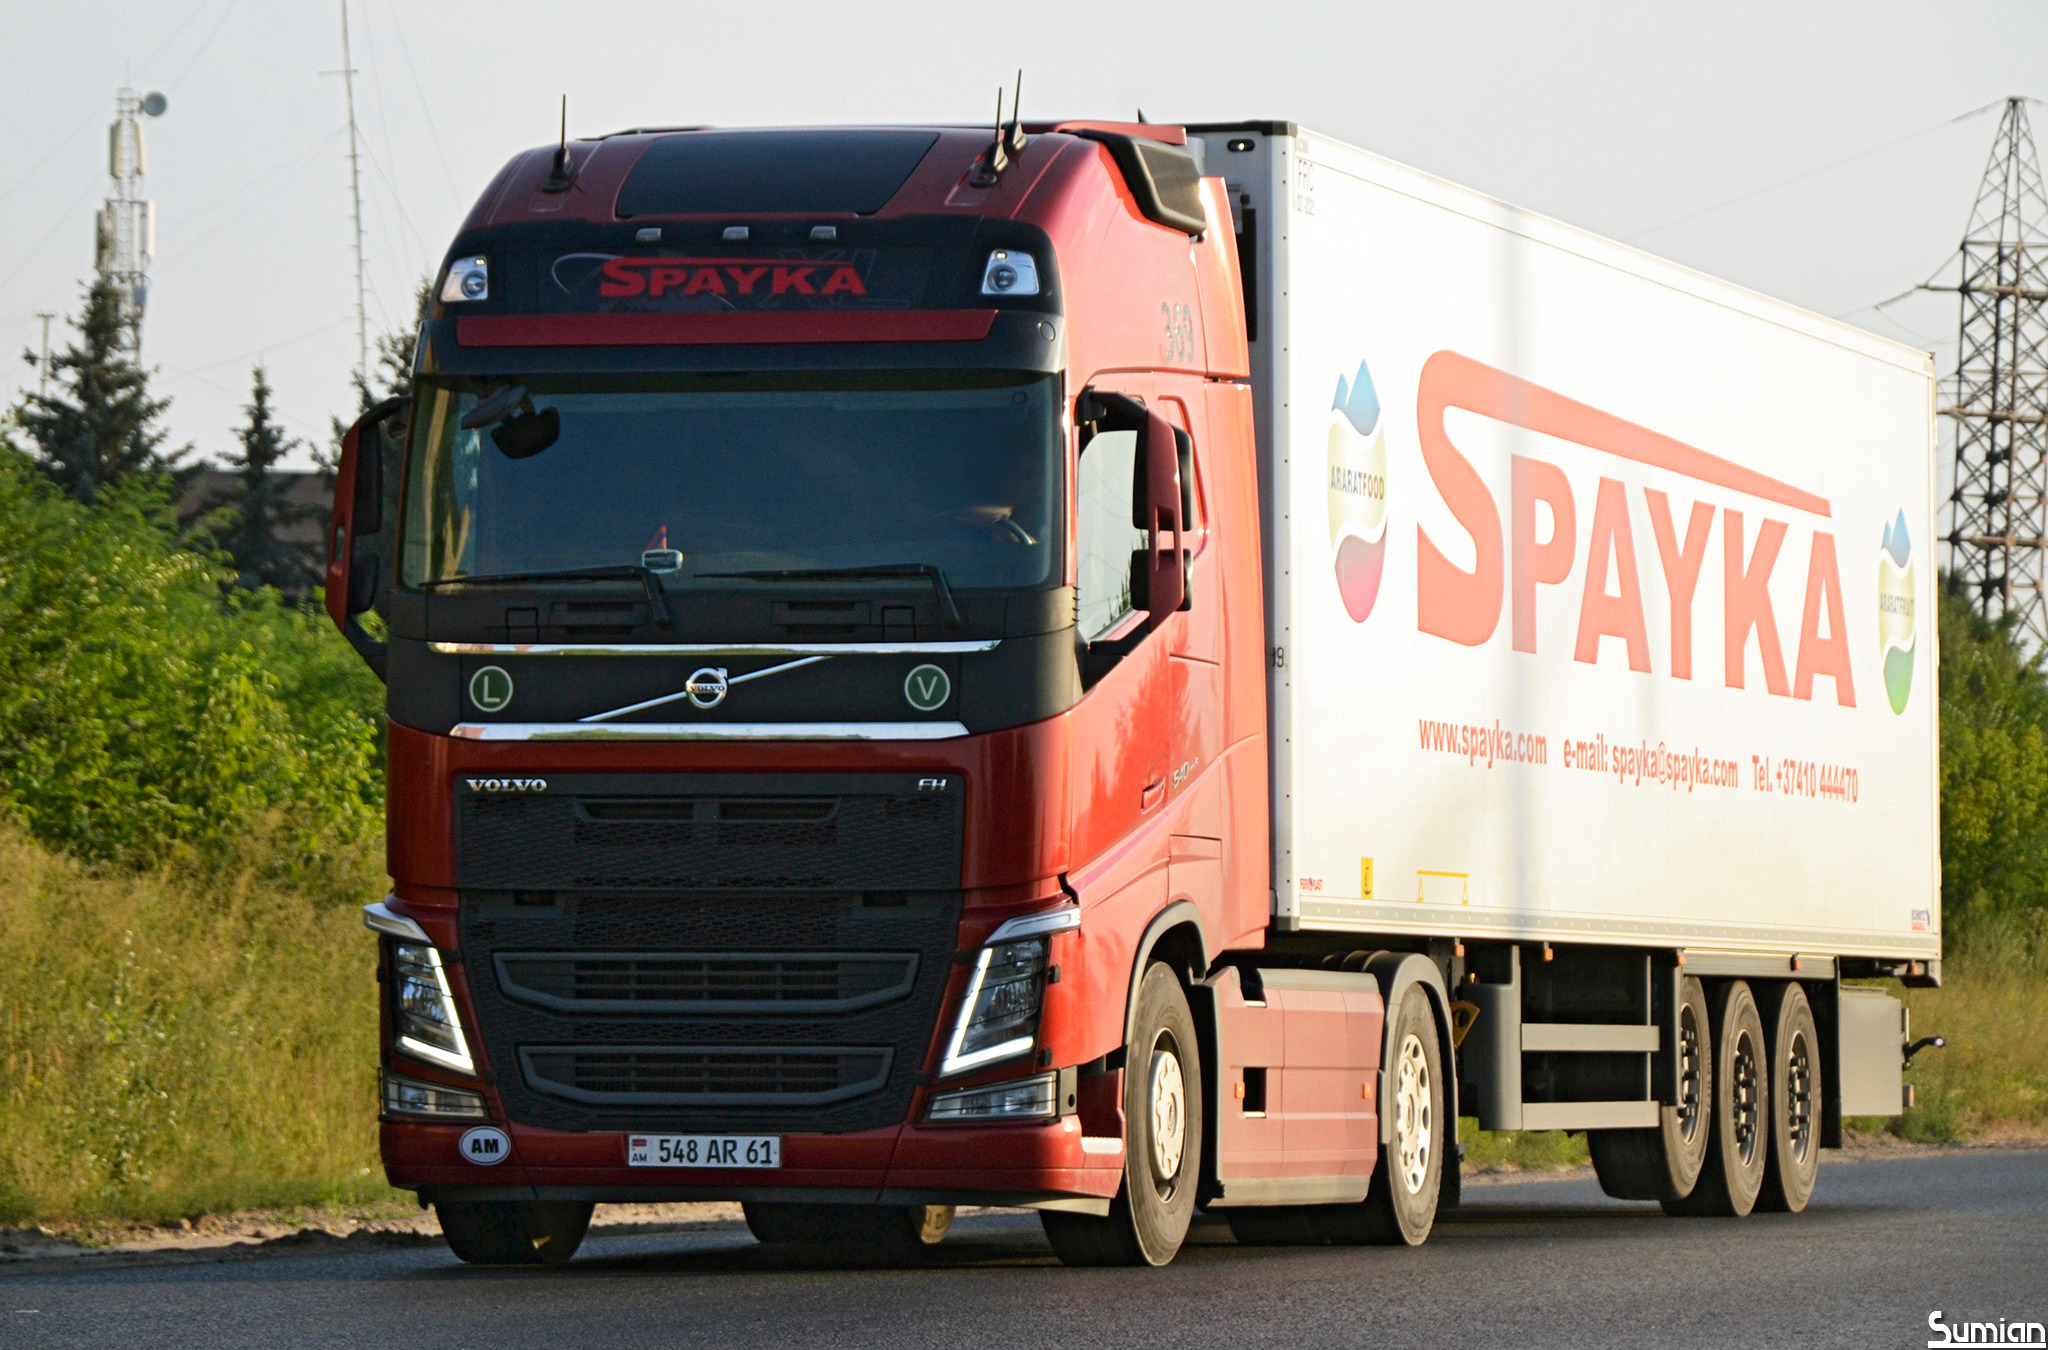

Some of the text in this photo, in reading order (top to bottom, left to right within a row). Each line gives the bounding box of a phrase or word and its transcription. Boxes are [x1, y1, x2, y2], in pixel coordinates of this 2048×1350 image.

[600, 256, 867, 297] SPAYKA
[1161, 302, 1194, 362] 369
[1330, 465, 1385, 501] ARARATFOOD
[1417, 349, 1858, 709] SPAYKA
[483, 675, 500, 703] L
[917, 676, 938, 701] V
[1418, 719, 1547, 770] www.spayka.com
[1563, 733, 1739, 793] e-mail: spayka@spayka.com
[1752, 754, 1858, 803] Tel. +37410 444470
[466, 778, 548, 792] VOLVO
[918, 779, 947, 791] FH
[470, 1138, 499, 1154] AM
[631, 1153, 648, 1163] AM
[659, 1138, 772, 1165] 548 AR 61
